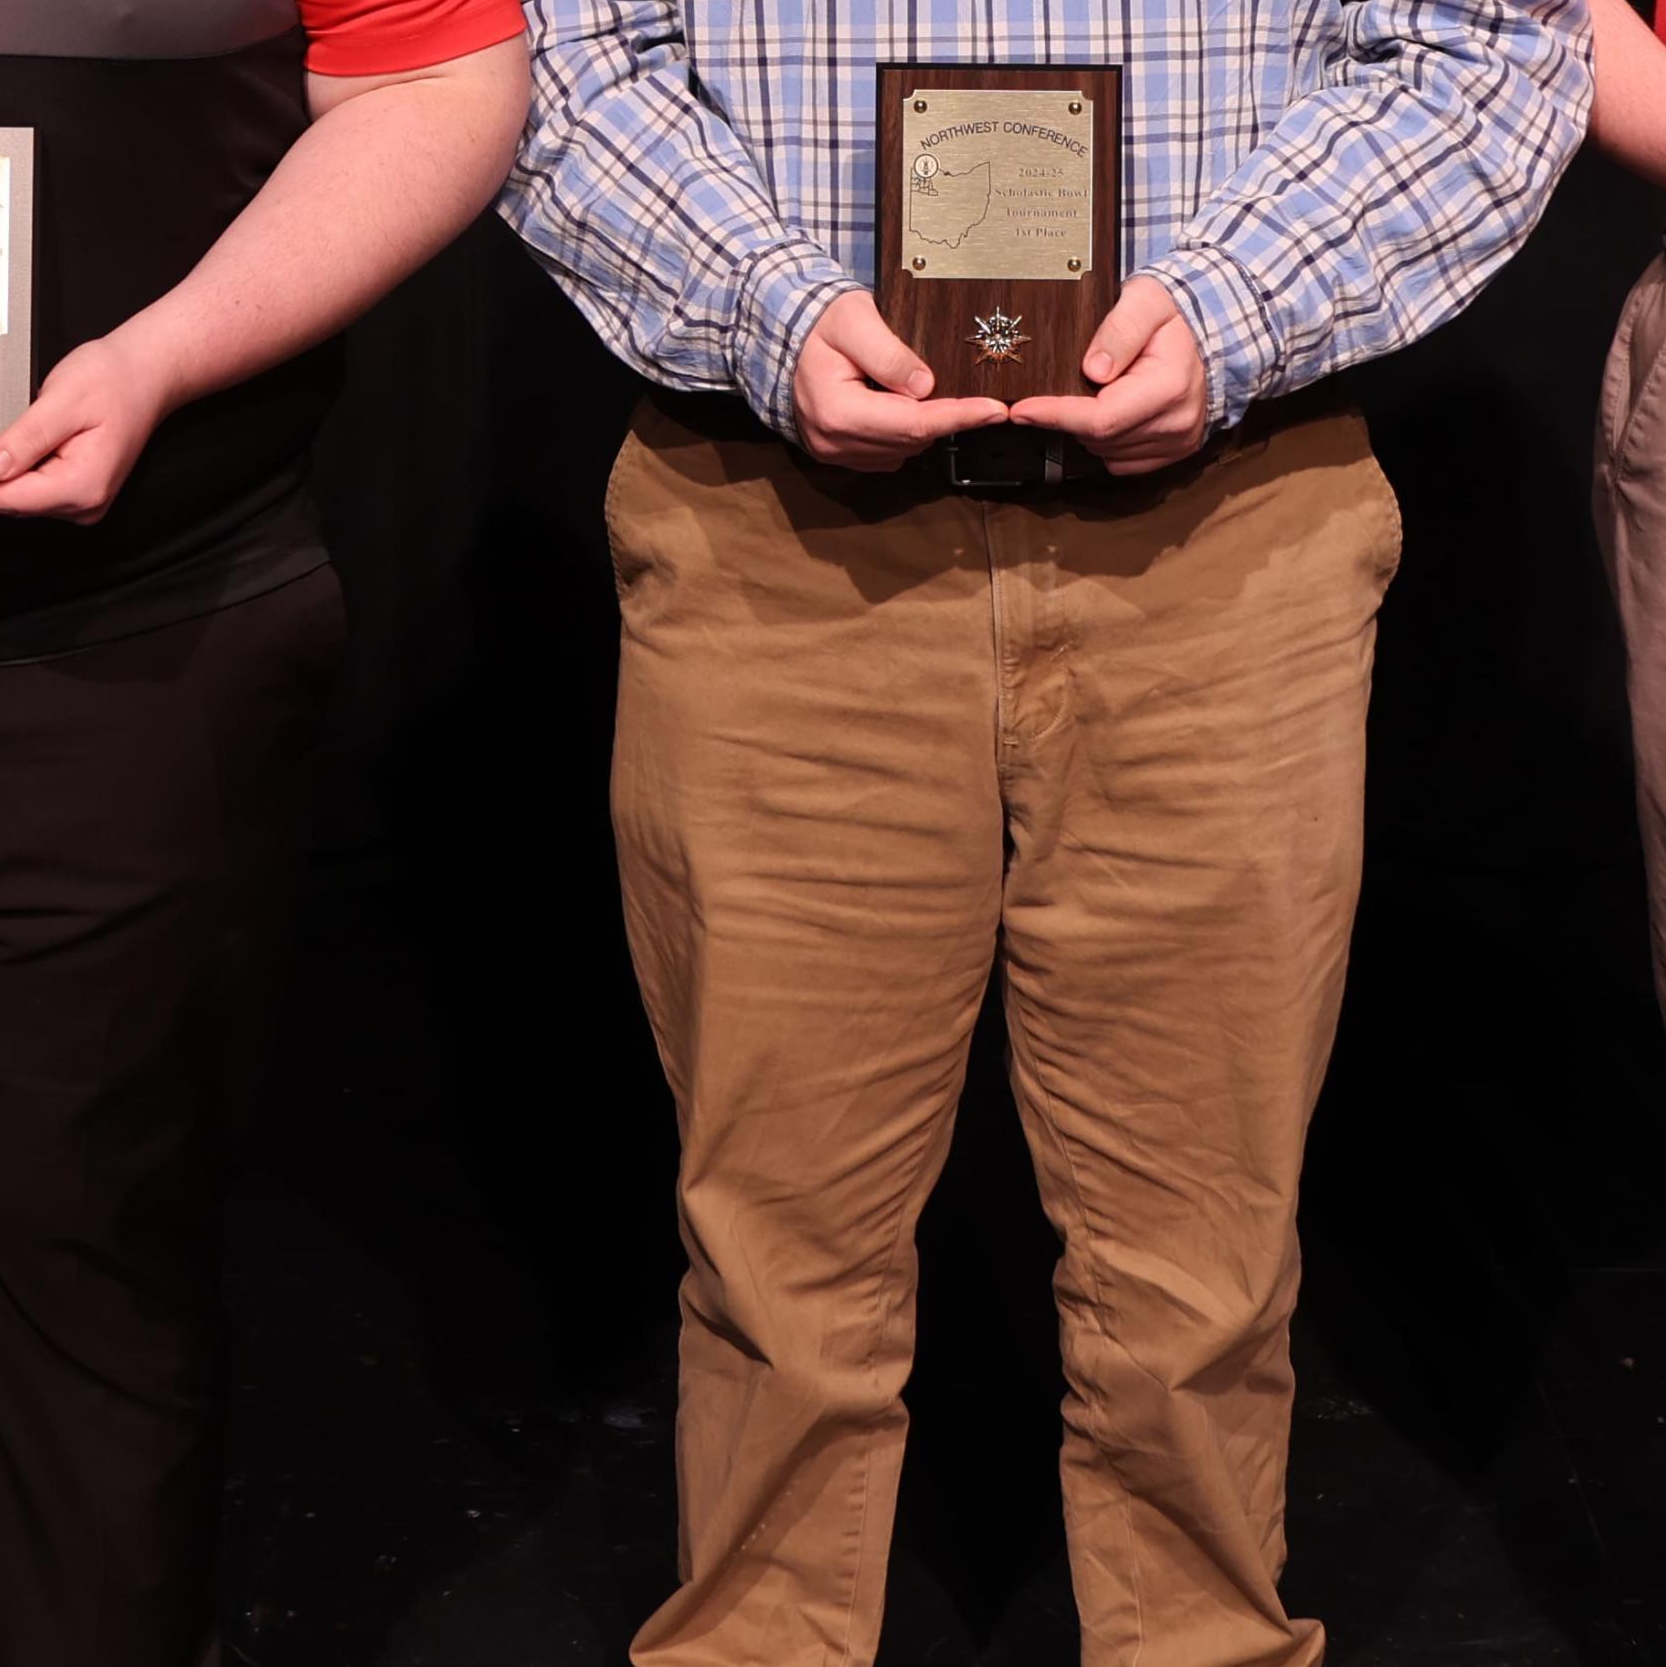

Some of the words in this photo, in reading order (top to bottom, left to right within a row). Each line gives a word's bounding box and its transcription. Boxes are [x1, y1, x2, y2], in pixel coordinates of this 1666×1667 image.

[920, 122, 999, 150] NORTHWEST
[1003, 122, 1088, 158] CONFERENCE
[1019, 168, 1064, 177] 2024-25
[995, 188, 1054, 197] Scholastic
[1058, 189, 1089, 197] Bowl
[1006, 208, 1077, 217] Tournament
[1016, 228, 1032, 237] 1st
[1036, 228, 1066, 237] Place
